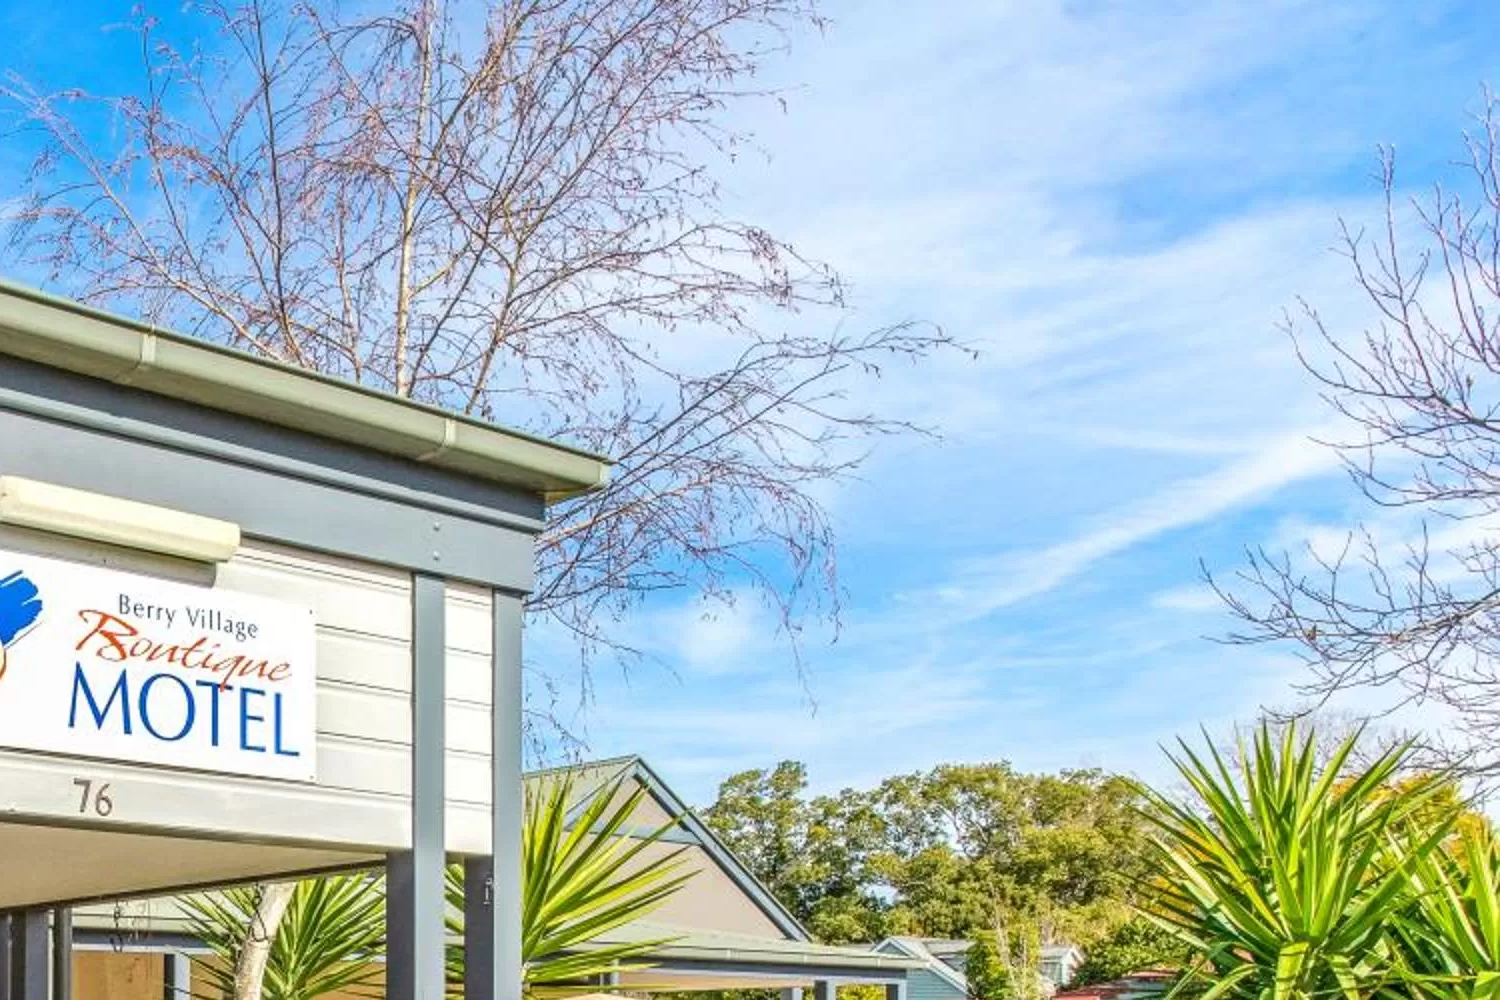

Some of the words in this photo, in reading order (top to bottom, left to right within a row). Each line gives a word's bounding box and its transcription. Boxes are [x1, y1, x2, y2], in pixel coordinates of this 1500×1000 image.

[118, 593, 177, 629] Berry
[185, 607, 259, 642] Village
[76, 609, 293, 693] Boutique
[67, 660, 301, 757] MOTEL
[73, 777, 113, 817] 76
